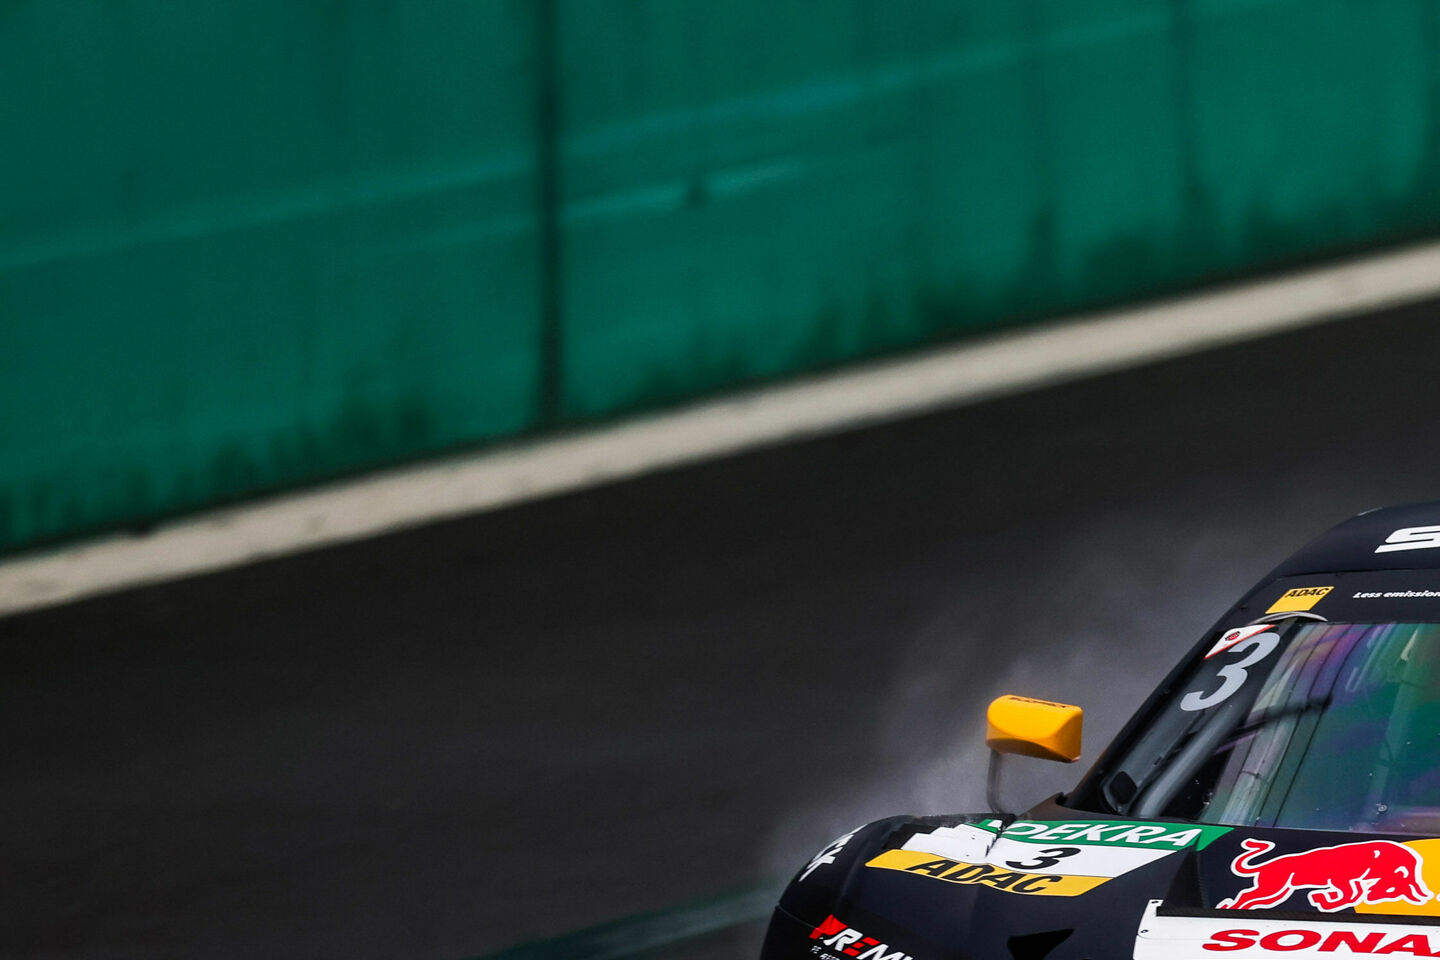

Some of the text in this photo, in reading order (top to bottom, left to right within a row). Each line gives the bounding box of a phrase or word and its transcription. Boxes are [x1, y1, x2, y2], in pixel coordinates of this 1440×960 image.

[1285, 587, 1330, 598] ADAC
[1180, 632, 1280, 711] 3
[996, 819, 1203, 848] DEKRA
[1005, 847, 1081, 870] 3
[903, 859, 1064, 894] ADAC
